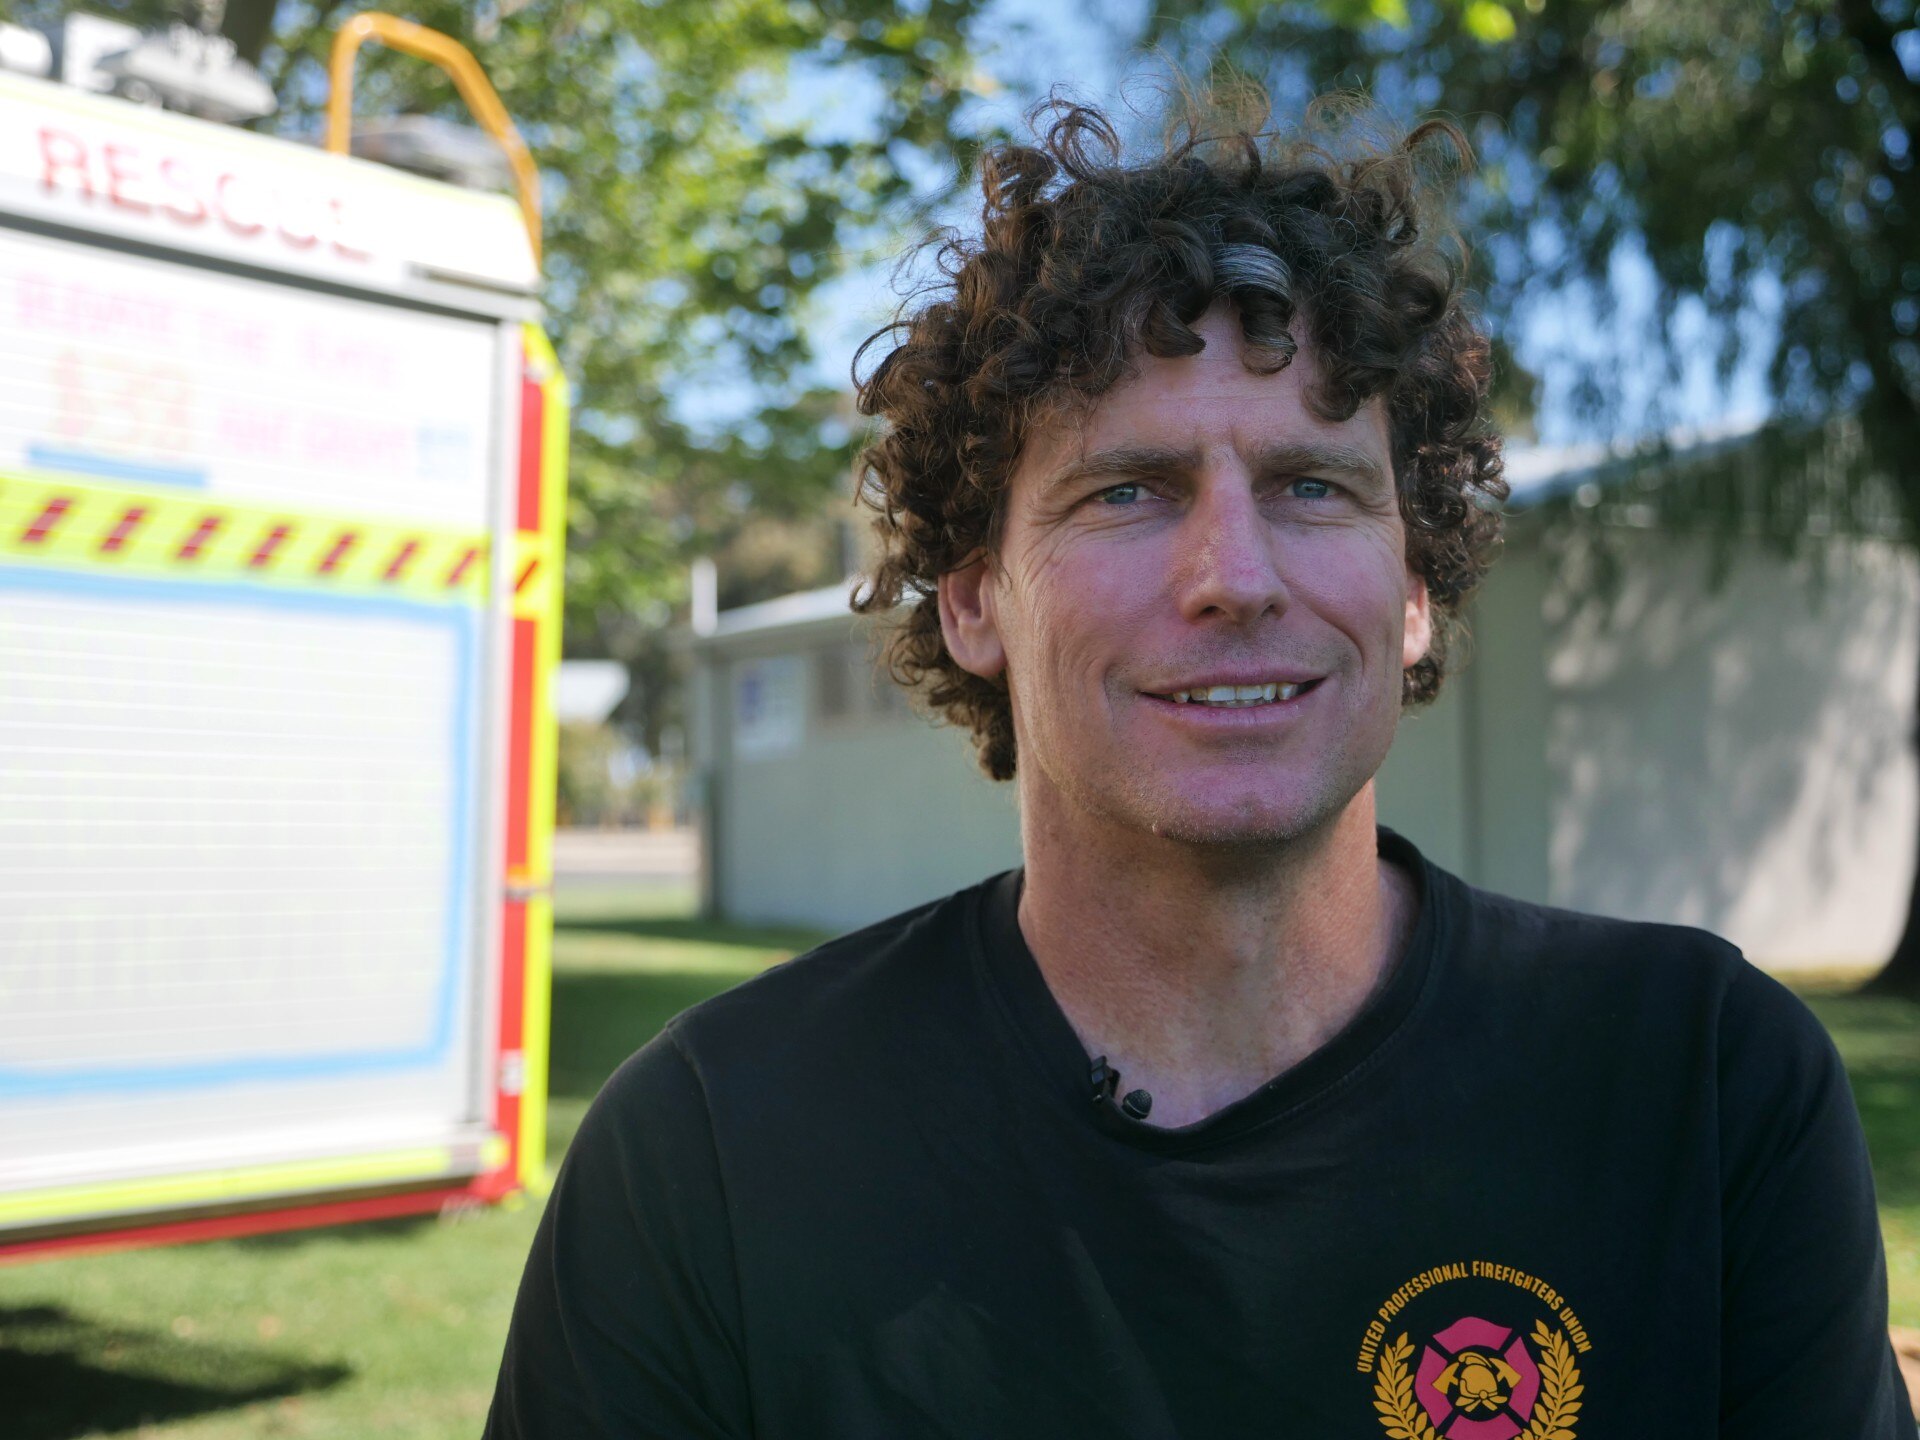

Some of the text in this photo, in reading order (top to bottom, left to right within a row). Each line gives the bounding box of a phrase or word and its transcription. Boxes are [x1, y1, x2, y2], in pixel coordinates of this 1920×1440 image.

[1357, 1260, 1592, 1373] UNITED PROFESSIONAL FIREFIGHTERS UNION
